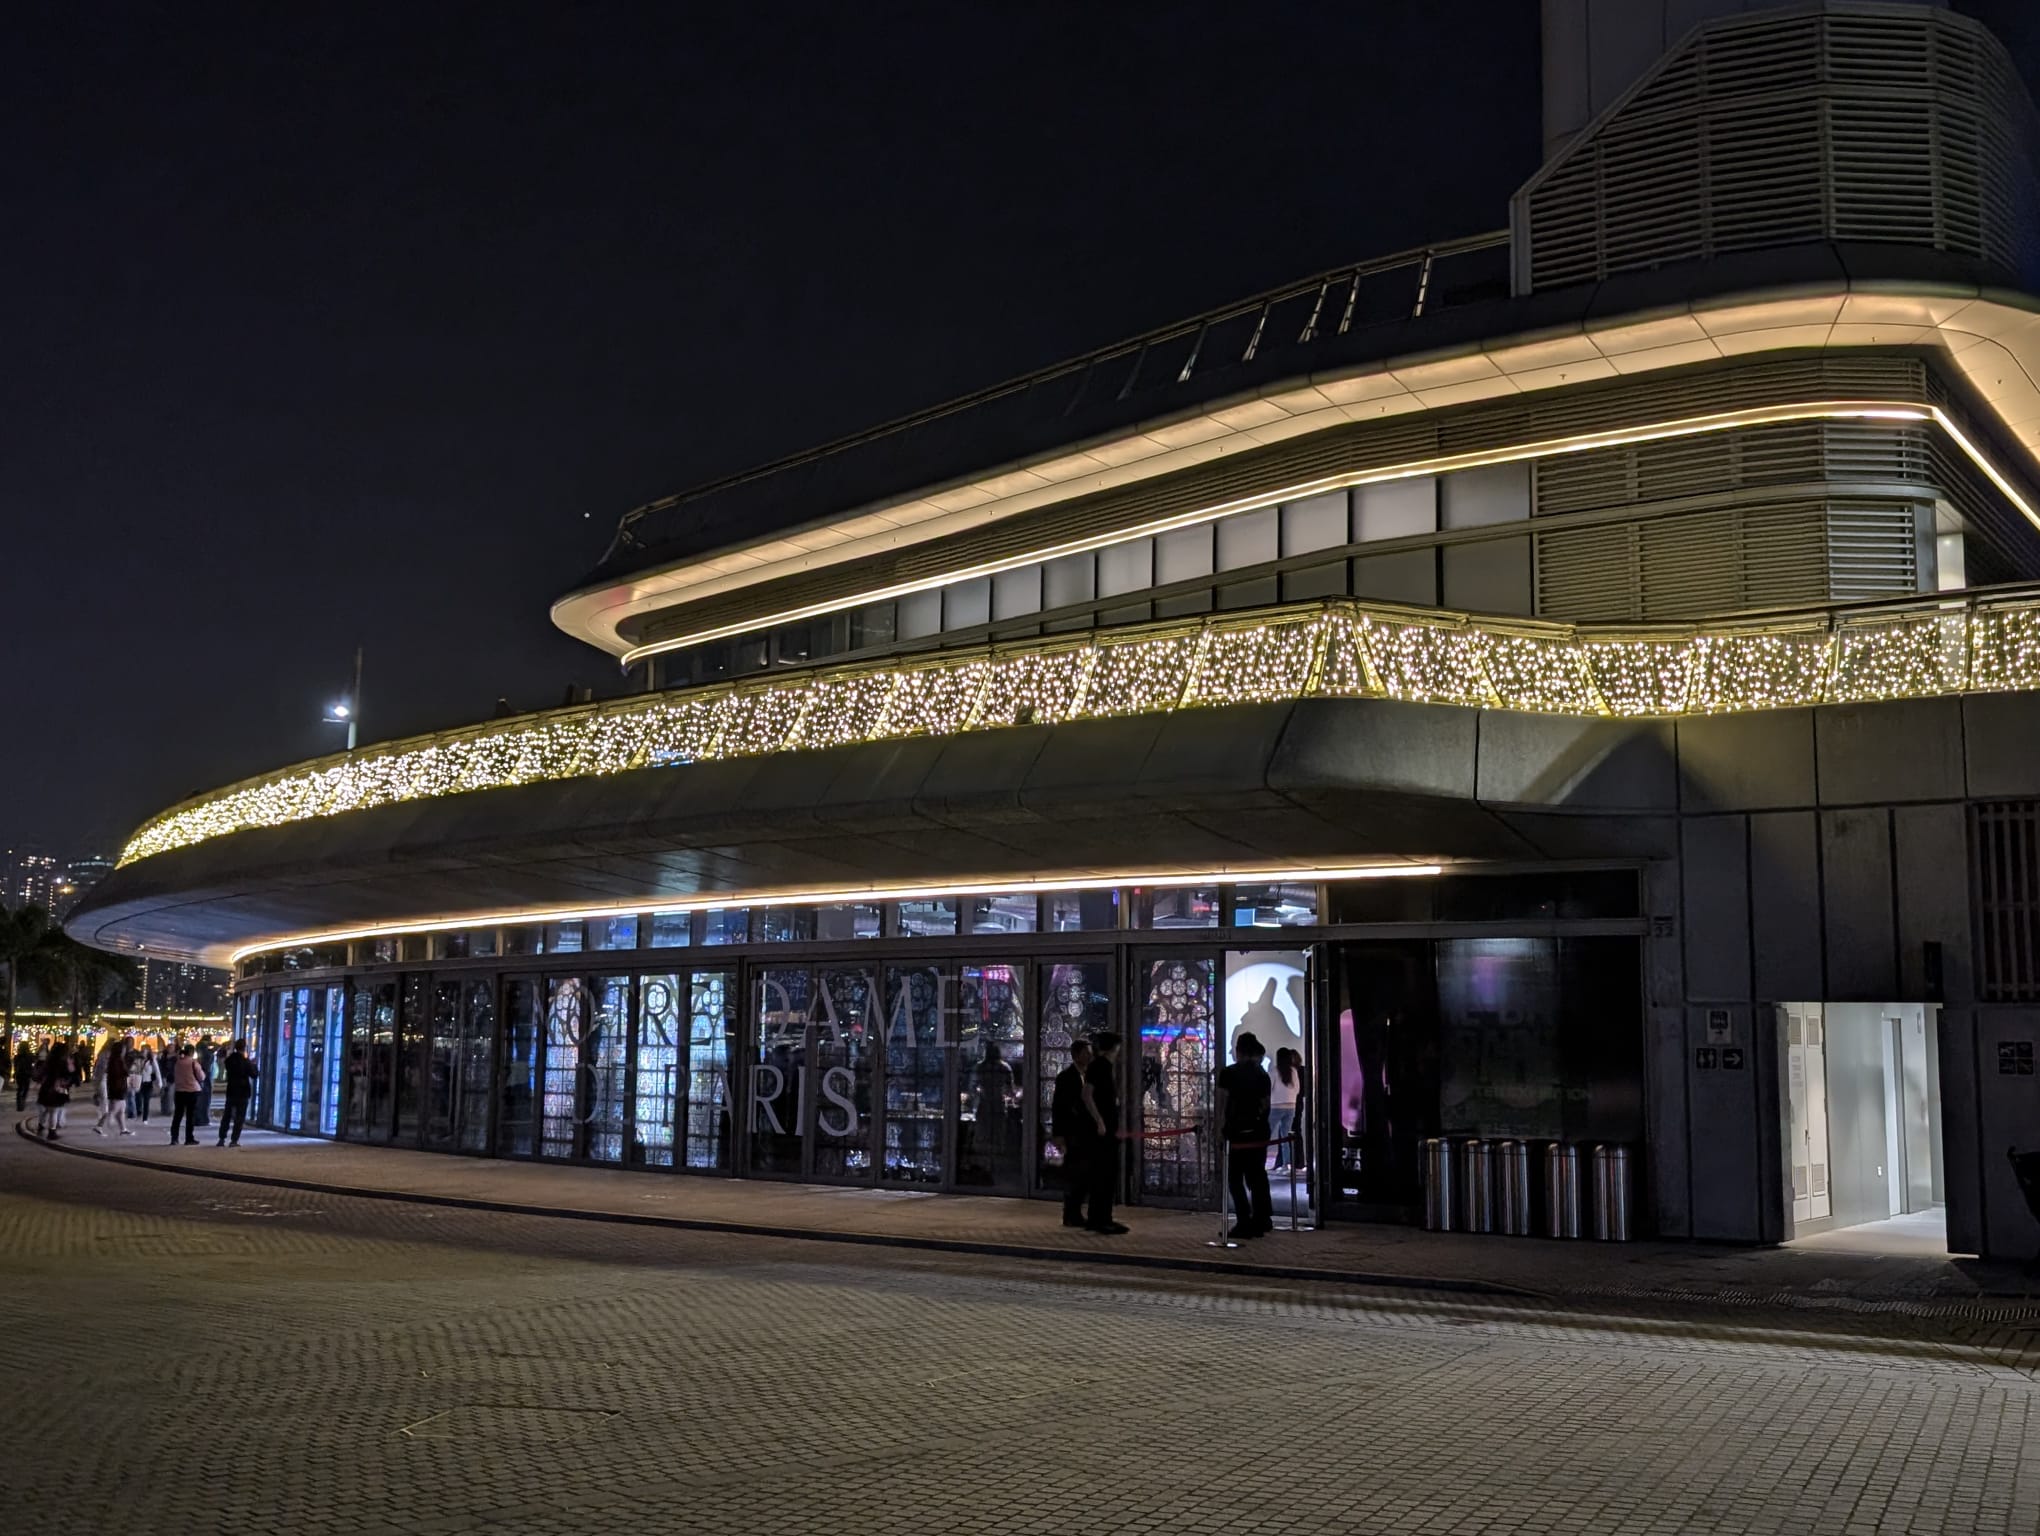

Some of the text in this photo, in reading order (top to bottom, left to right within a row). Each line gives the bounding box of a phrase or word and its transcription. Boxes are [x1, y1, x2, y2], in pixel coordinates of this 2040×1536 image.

[750, 975, 980, 1048] DAME
[571, 1063, 858, 1137] DE PARIS
